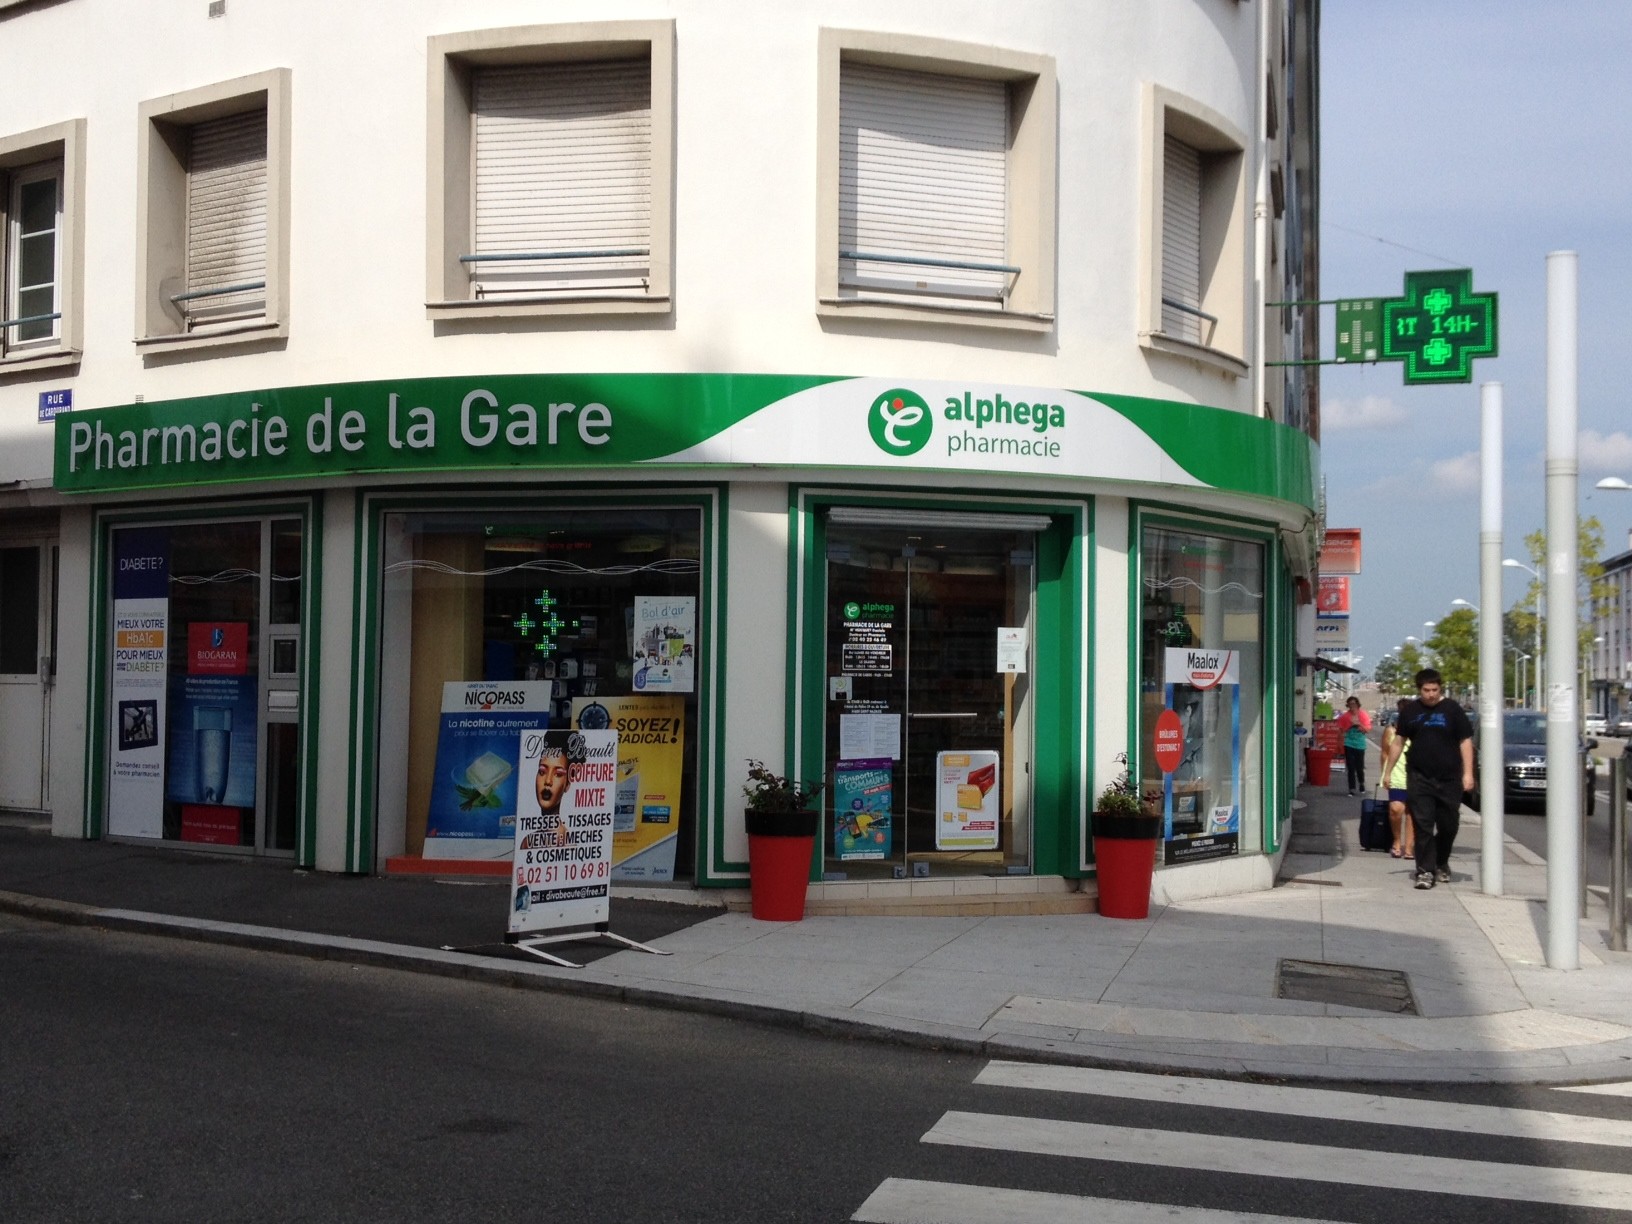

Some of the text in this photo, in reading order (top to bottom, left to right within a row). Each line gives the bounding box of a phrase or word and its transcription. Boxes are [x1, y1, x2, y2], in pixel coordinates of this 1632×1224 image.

[47, 393, 64, 405] RUE
[944, 391, 1066, 433] alphega
[69, 388, 613, 473] Pharmacie de la Gare
[947, 429, 1062, 458] pharmacie
[641, 606, 659, 619] Bol
[862, 602, 895, 613] alphega
[117, 618, 165, 629] MIEUX VOTRE
[116, 650, 164, 660] POUR MIEUX
[197, 650, 237, 660] BIOGARAN
[1187, 652, 1219, 669] Maalox
[448, 718, 539, 728] La nicotine autrement
[616, 717, 671, 732] SOYEZ
[524, 732, 616, 760] Diva Beauté
[568, 762, 614, 783] COIFFURE
[574, 787, 606, 808] MIXTE
[520, 815, 560, 831] TRESSES
[568, 812, 612, 828] TISSAGES
[526, 832, 557, 848] VENTE
[565, 829, 603, 846] MECHES
[526, 846, 602, 864] & COSMETIQUES
[527, 867, 542, 884] 02
[545, 866, 558, 882] 51
[564, 864, 577, 881] 10
[581, 862, 594, 879] 69
[597, 861, 610, 878] 81
[545, 887, 606, 901] divabeaute@free.fr
